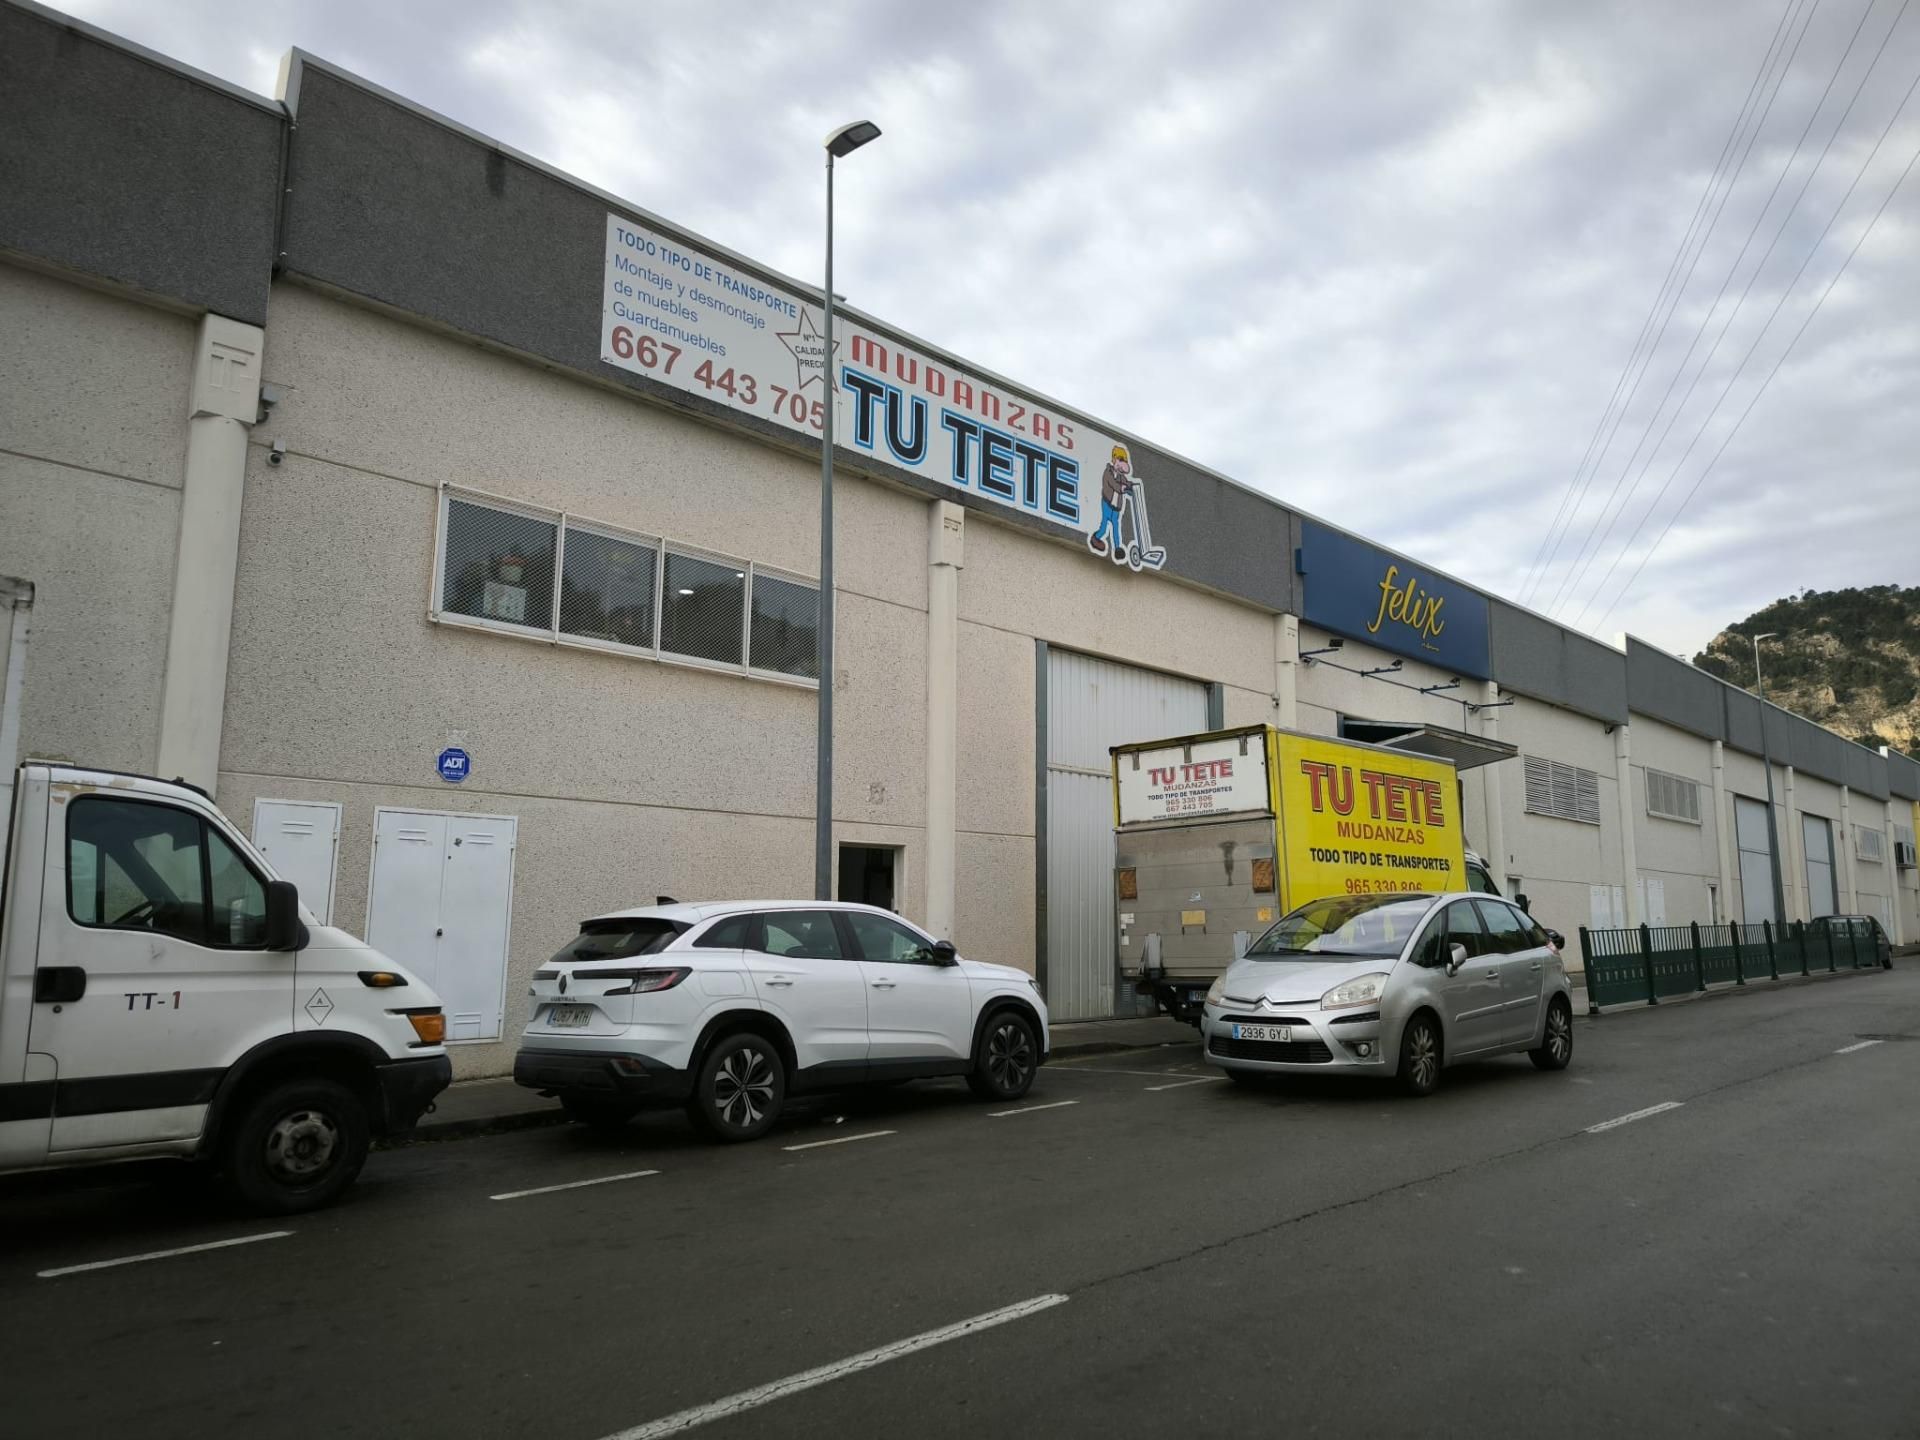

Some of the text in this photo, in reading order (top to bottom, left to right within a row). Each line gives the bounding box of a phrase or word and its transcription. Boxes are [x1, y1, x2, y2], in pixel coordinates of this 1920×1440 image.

[615, 254, 766, 330] Montaje y desmontaje
[616, 227, 798, 319] TODO TIPO DE TRANSPORTE
[614, 279, 699, 322] de muebles
[613, 301, 727, 357] Guardamuebles
[611, 325, 825, 431] 667 443 705
[852, 334, 1074, 450] MUDANZAS
[842, 366, 1079, 524] TU TETE
[1367, 565, 1445, 640] felix
[443, 757, 465, 769] ADT
[1147, 757, 1234, 786] TU TETE
[1163, 779, 1217, 792] MUDANZAS
[1165, 791, 1179, 799] TIPO
[1189, 786, 1233, 797] TRANSPORTES
[1301, 760, 1445, 827] TU TETE
[1337, 821, 1425, 845] MUDANZAS
[1310, 848, 1450, 871] TODO TIPO DE TRANSPORTES
[1345, 878, 1370, 894] 965
[1374, 880, 1397, 892] 330
[1241, 1026, 1288, 1041] 2936 GYJ
